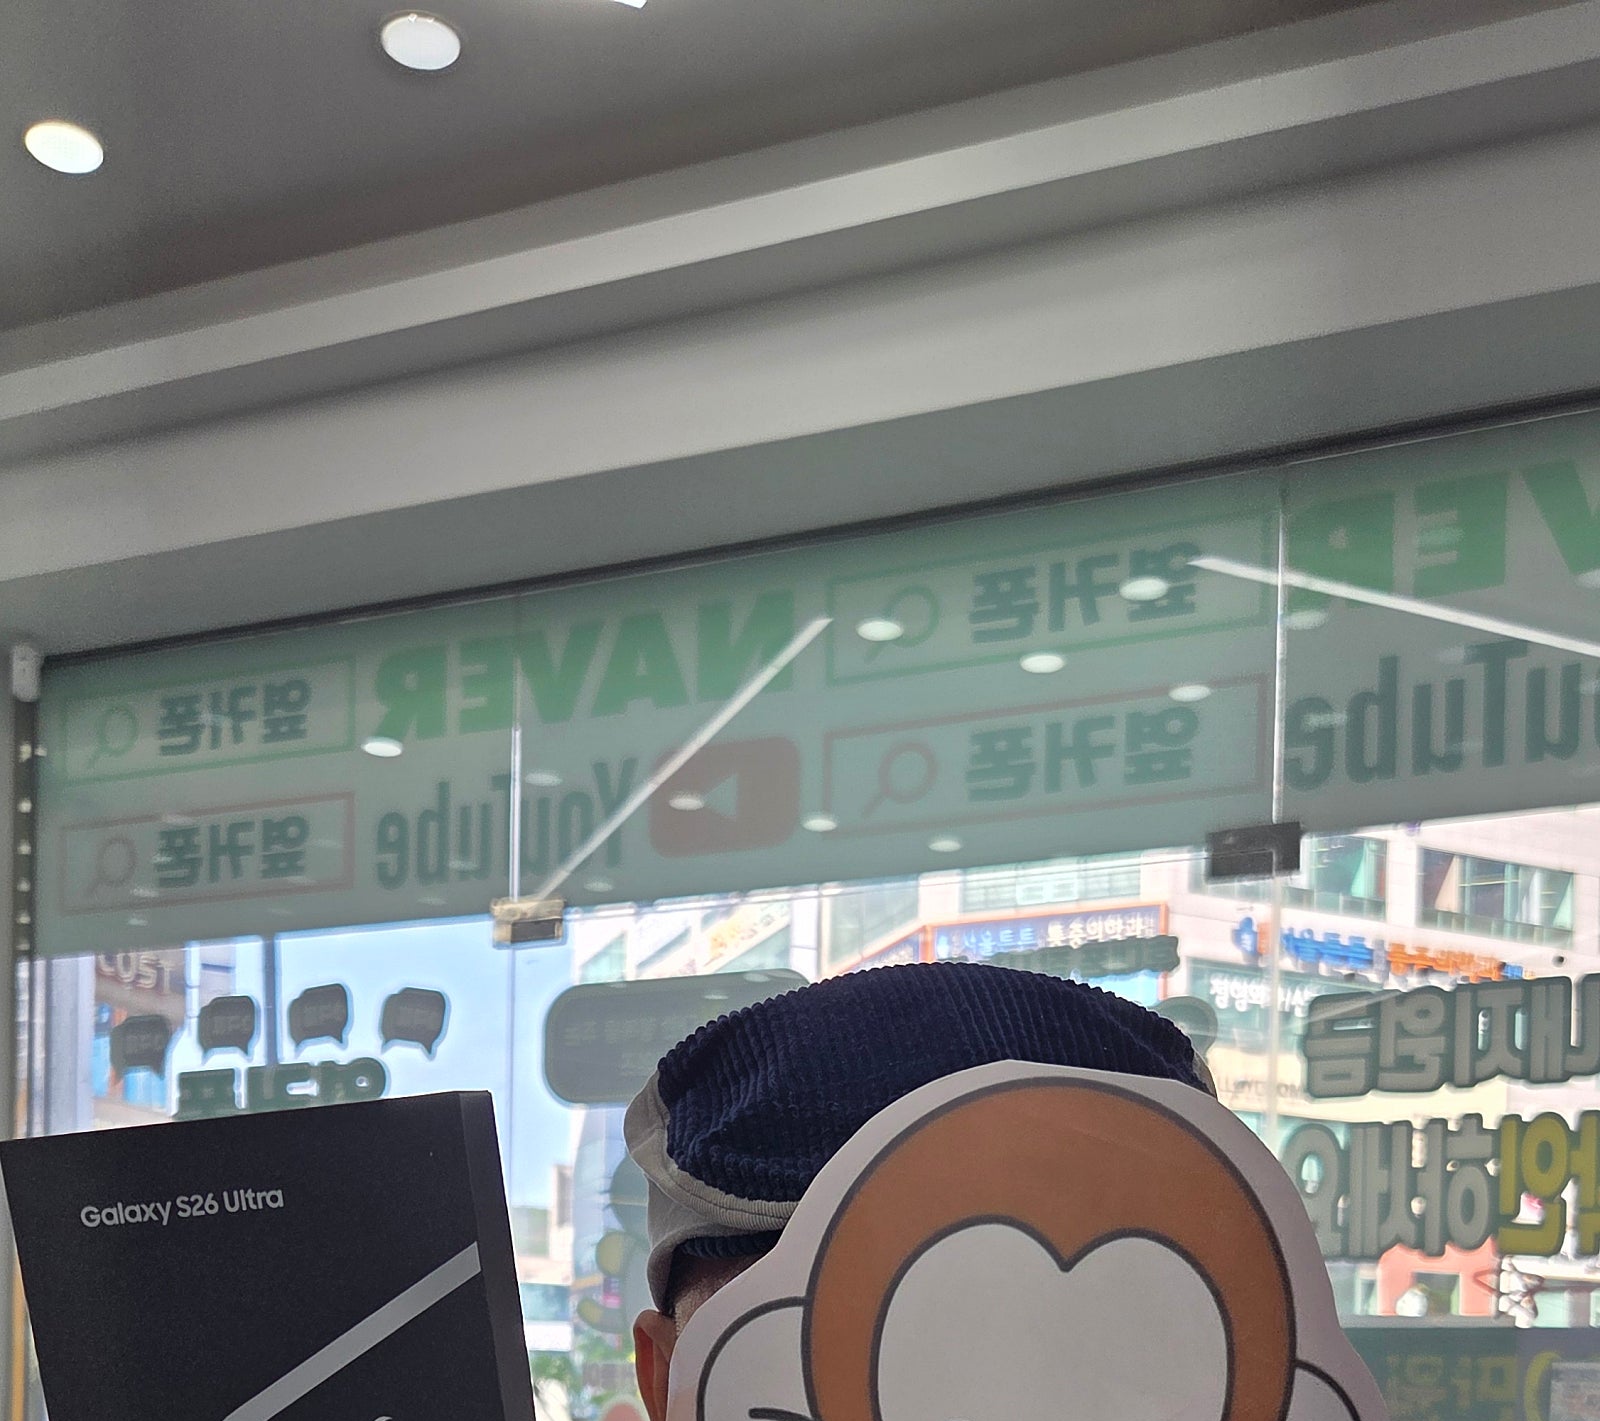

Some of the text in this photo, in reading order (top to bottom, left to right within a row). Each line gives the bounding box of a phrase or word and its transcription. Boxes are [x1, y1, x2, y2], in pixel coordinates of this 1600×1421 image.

[80, 1188, 285, 1227] Galaxy S26 Ultra
